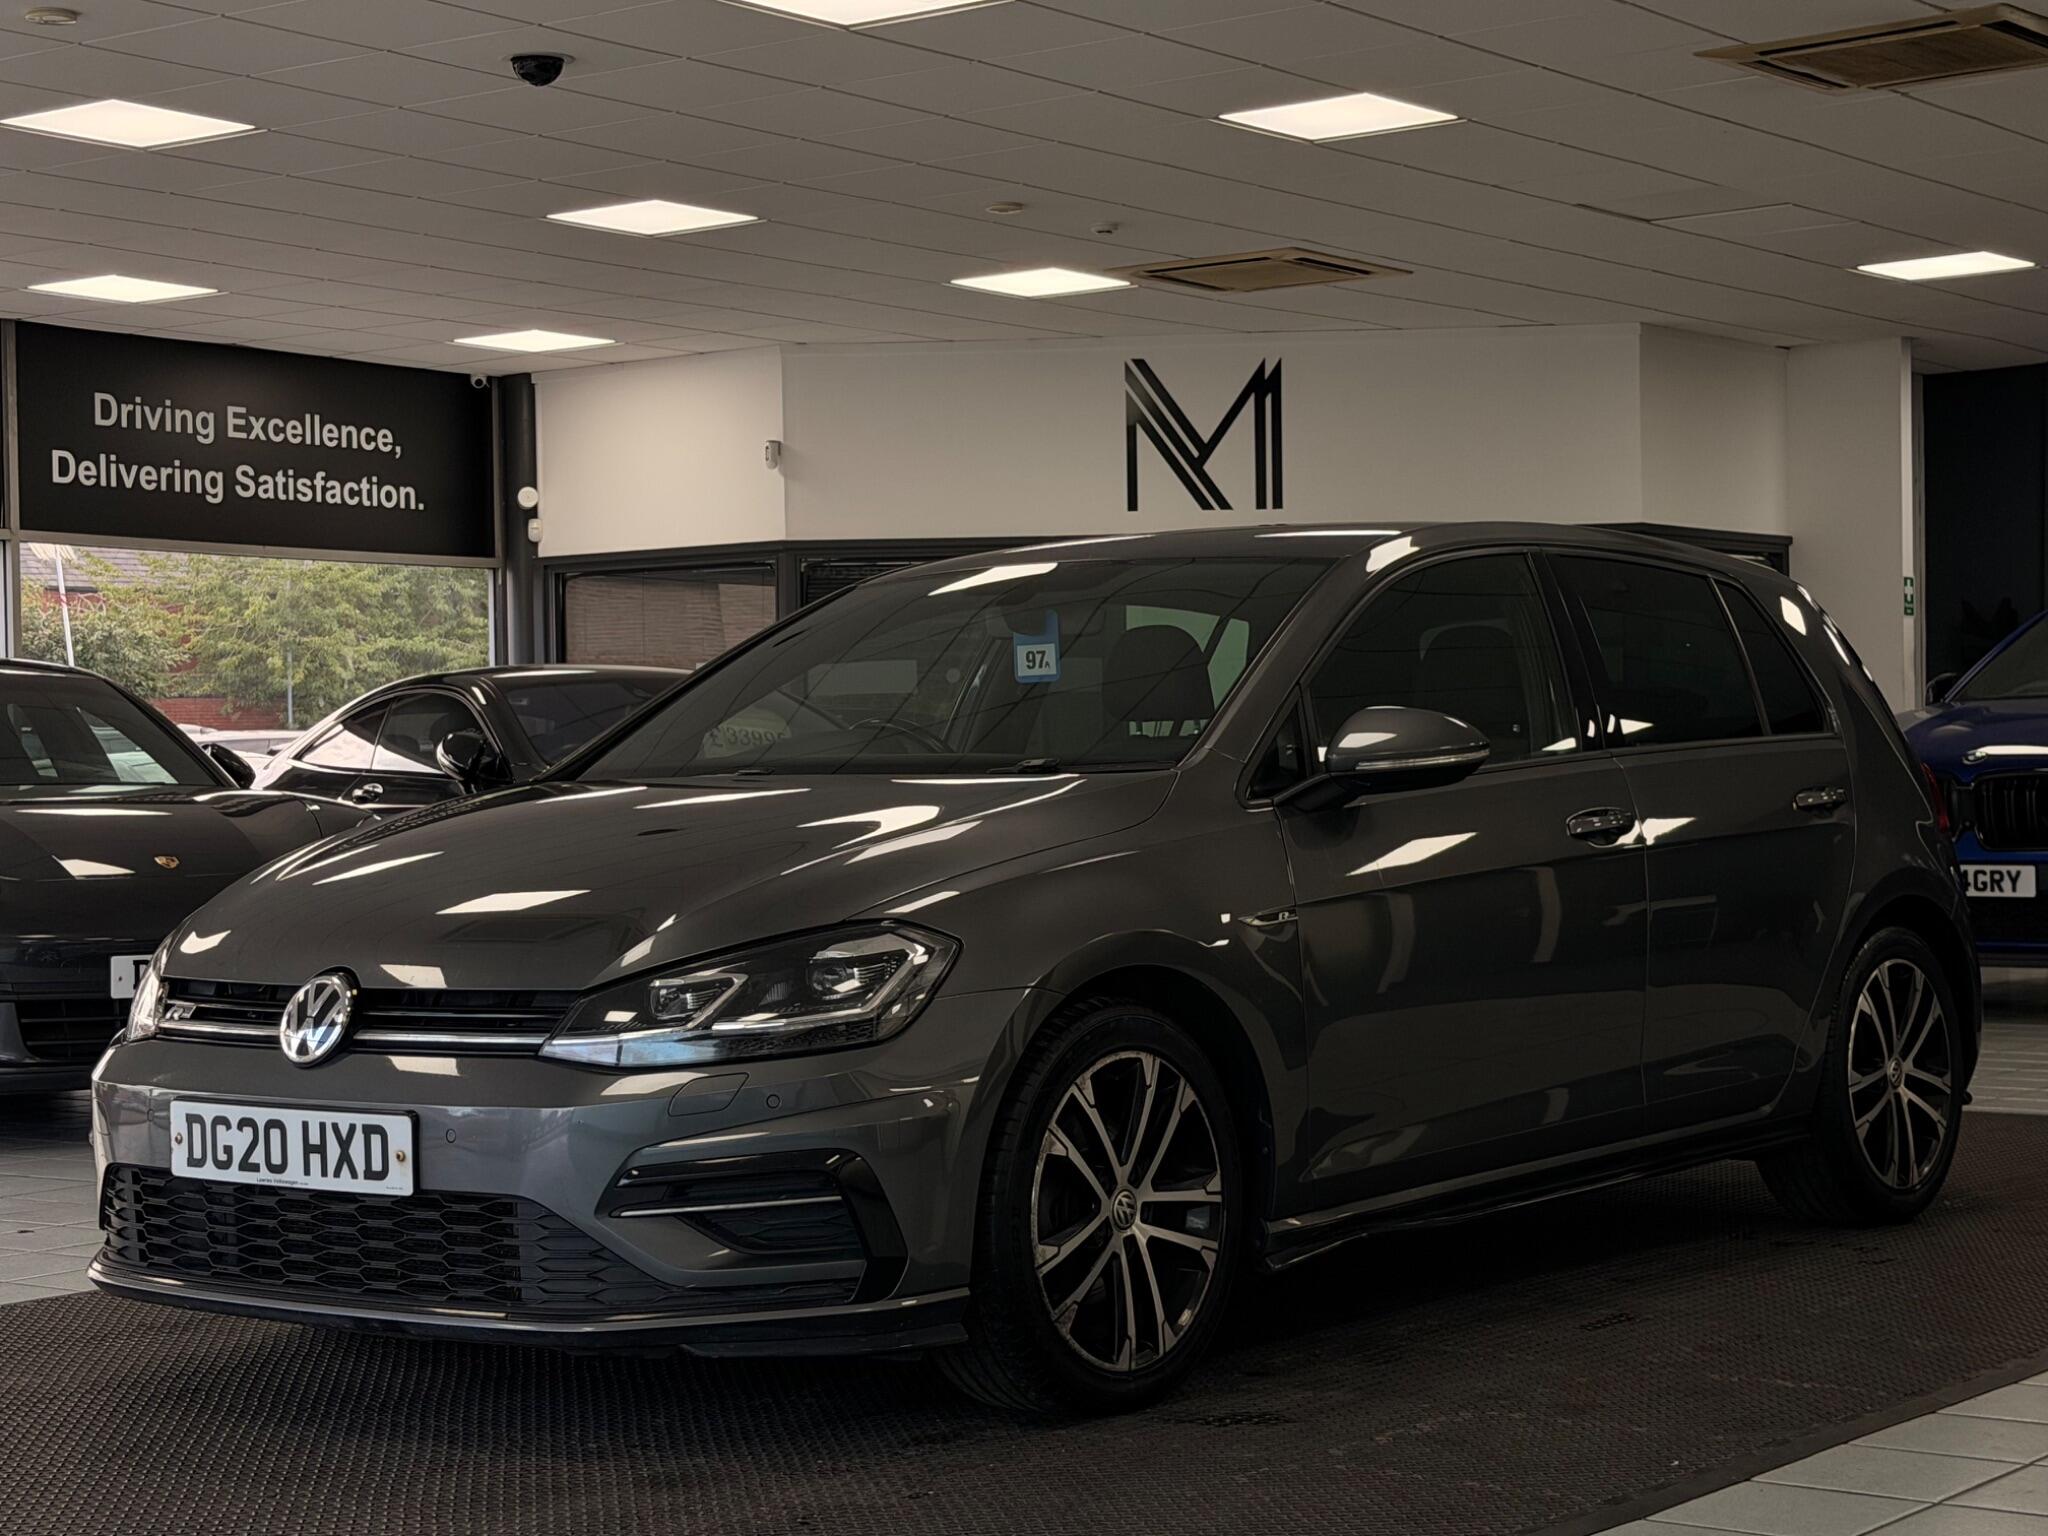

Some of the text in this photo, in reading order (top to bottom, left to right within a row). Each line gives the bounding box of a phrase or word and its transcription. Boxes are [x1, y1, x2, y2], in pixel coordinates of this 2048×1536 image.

[94, 392, 402, 459] Driving Excellence,
[51, 449, 425, 511] Delivering Satisfaction.
[185, 1113, 390, 1182] DG20 HXD
